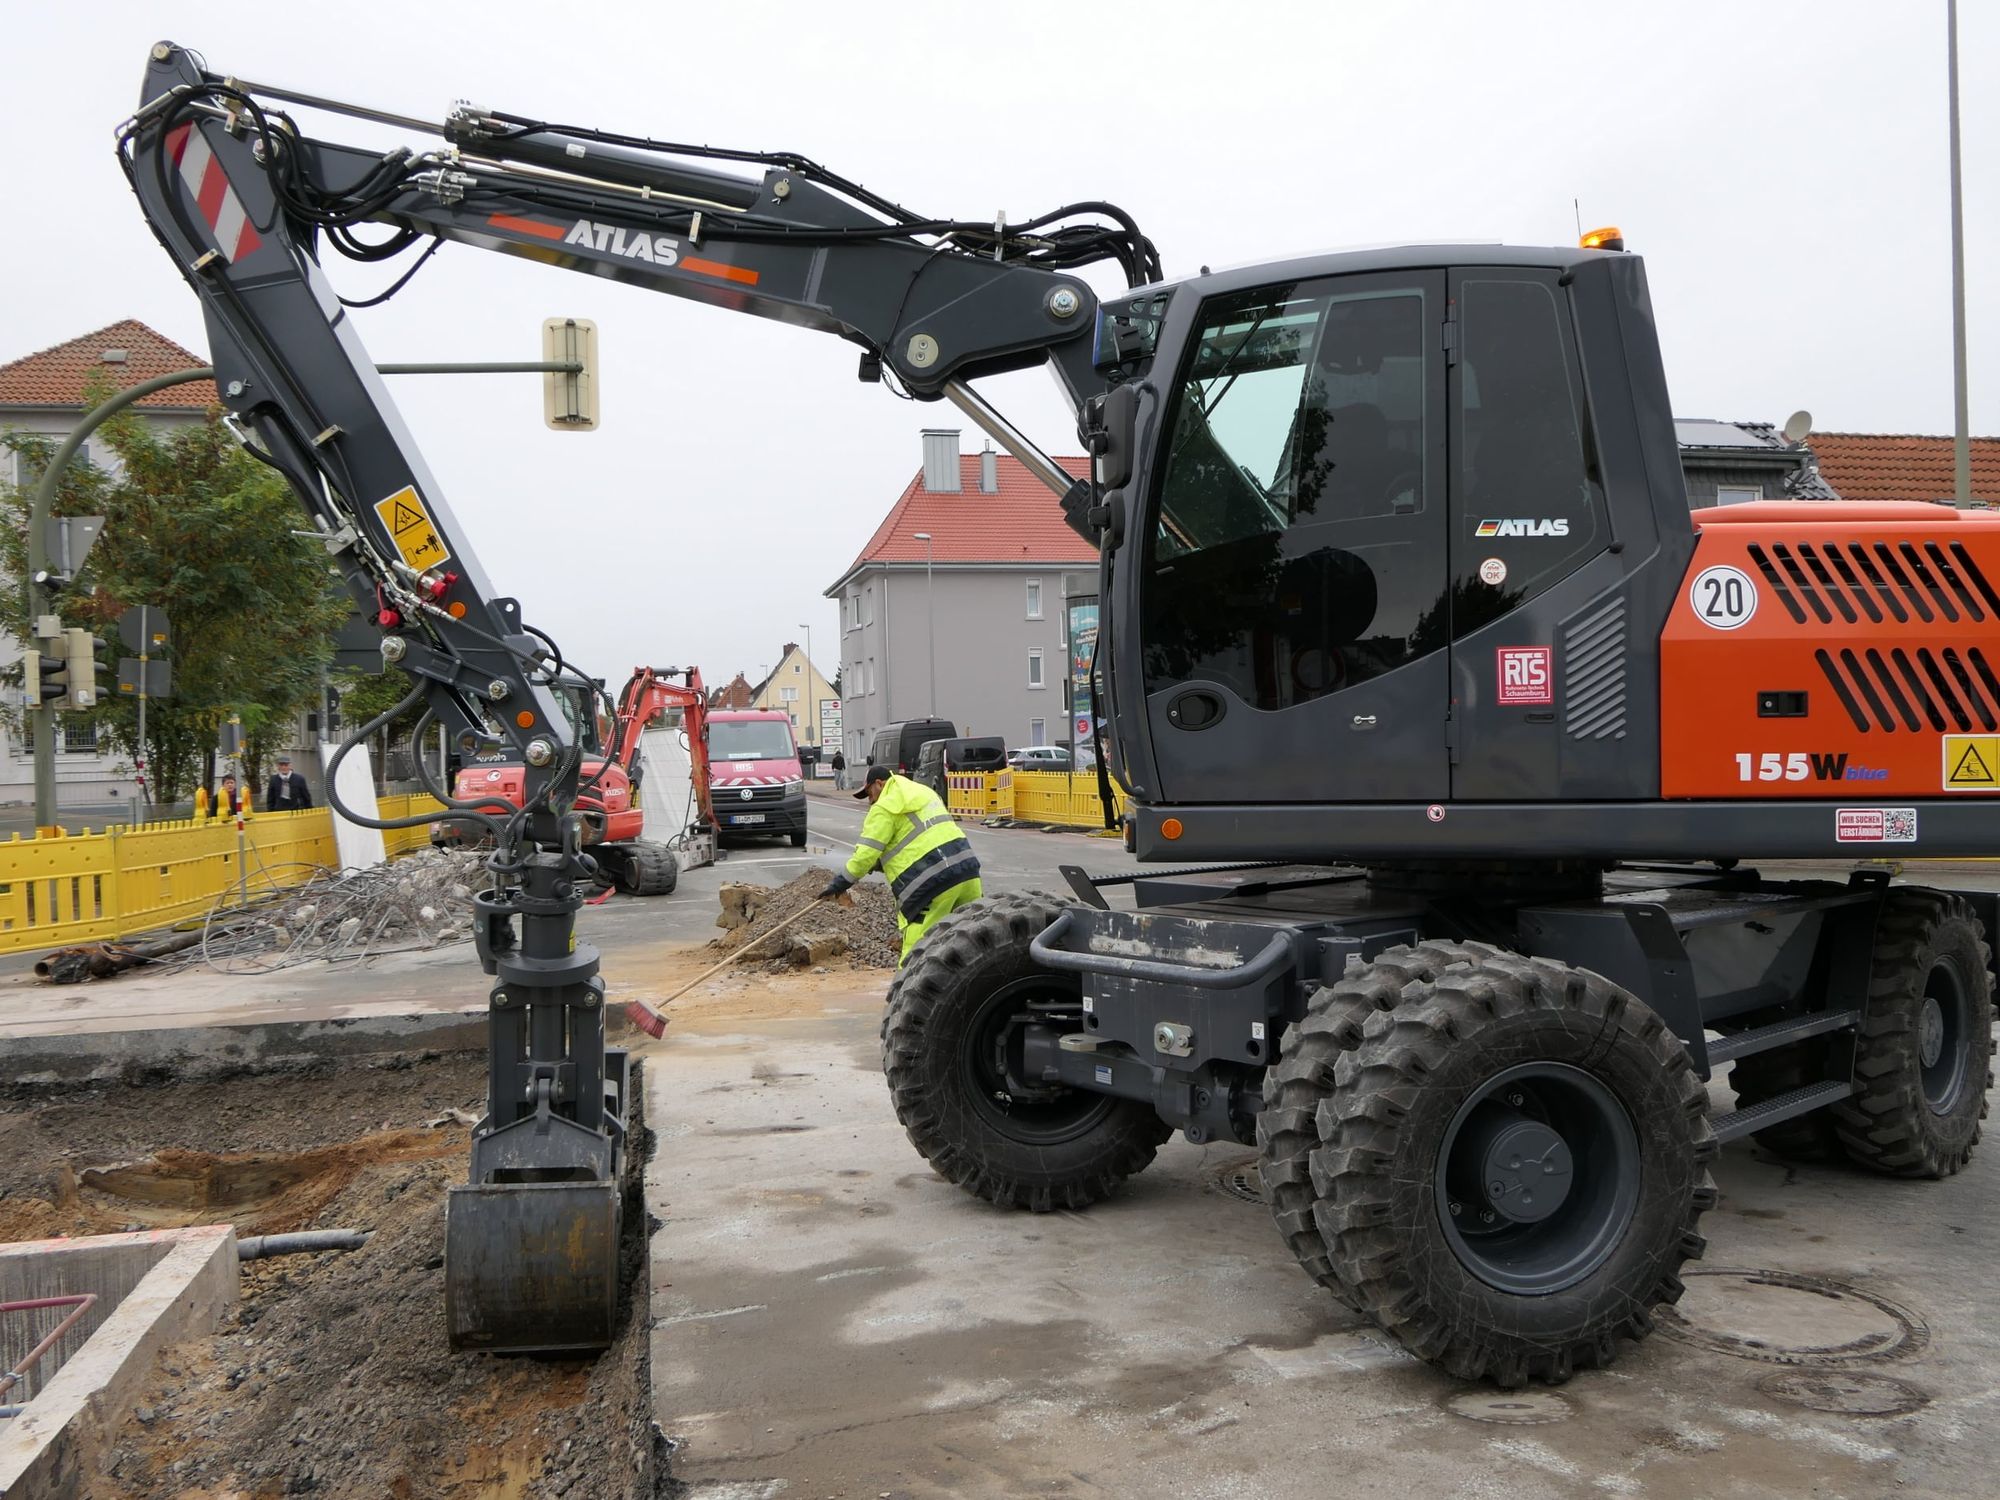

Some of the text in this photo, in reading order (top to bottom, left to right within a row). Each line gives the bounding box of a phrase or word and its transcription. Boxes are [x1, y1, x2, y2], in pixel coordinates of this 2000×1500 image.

[564, 219, 679, 266] ATLAS
[1497, 518, 1569, 536] ATLAS
[1486, 571, 1501, 580] OK
[1704, 578, 1743, 617] 20
[1504, 653, 1546, 685] RTS
[1846, 766, 1888, 781] blue
[1841, 815, 1880, 824] WIR SUCHEN
